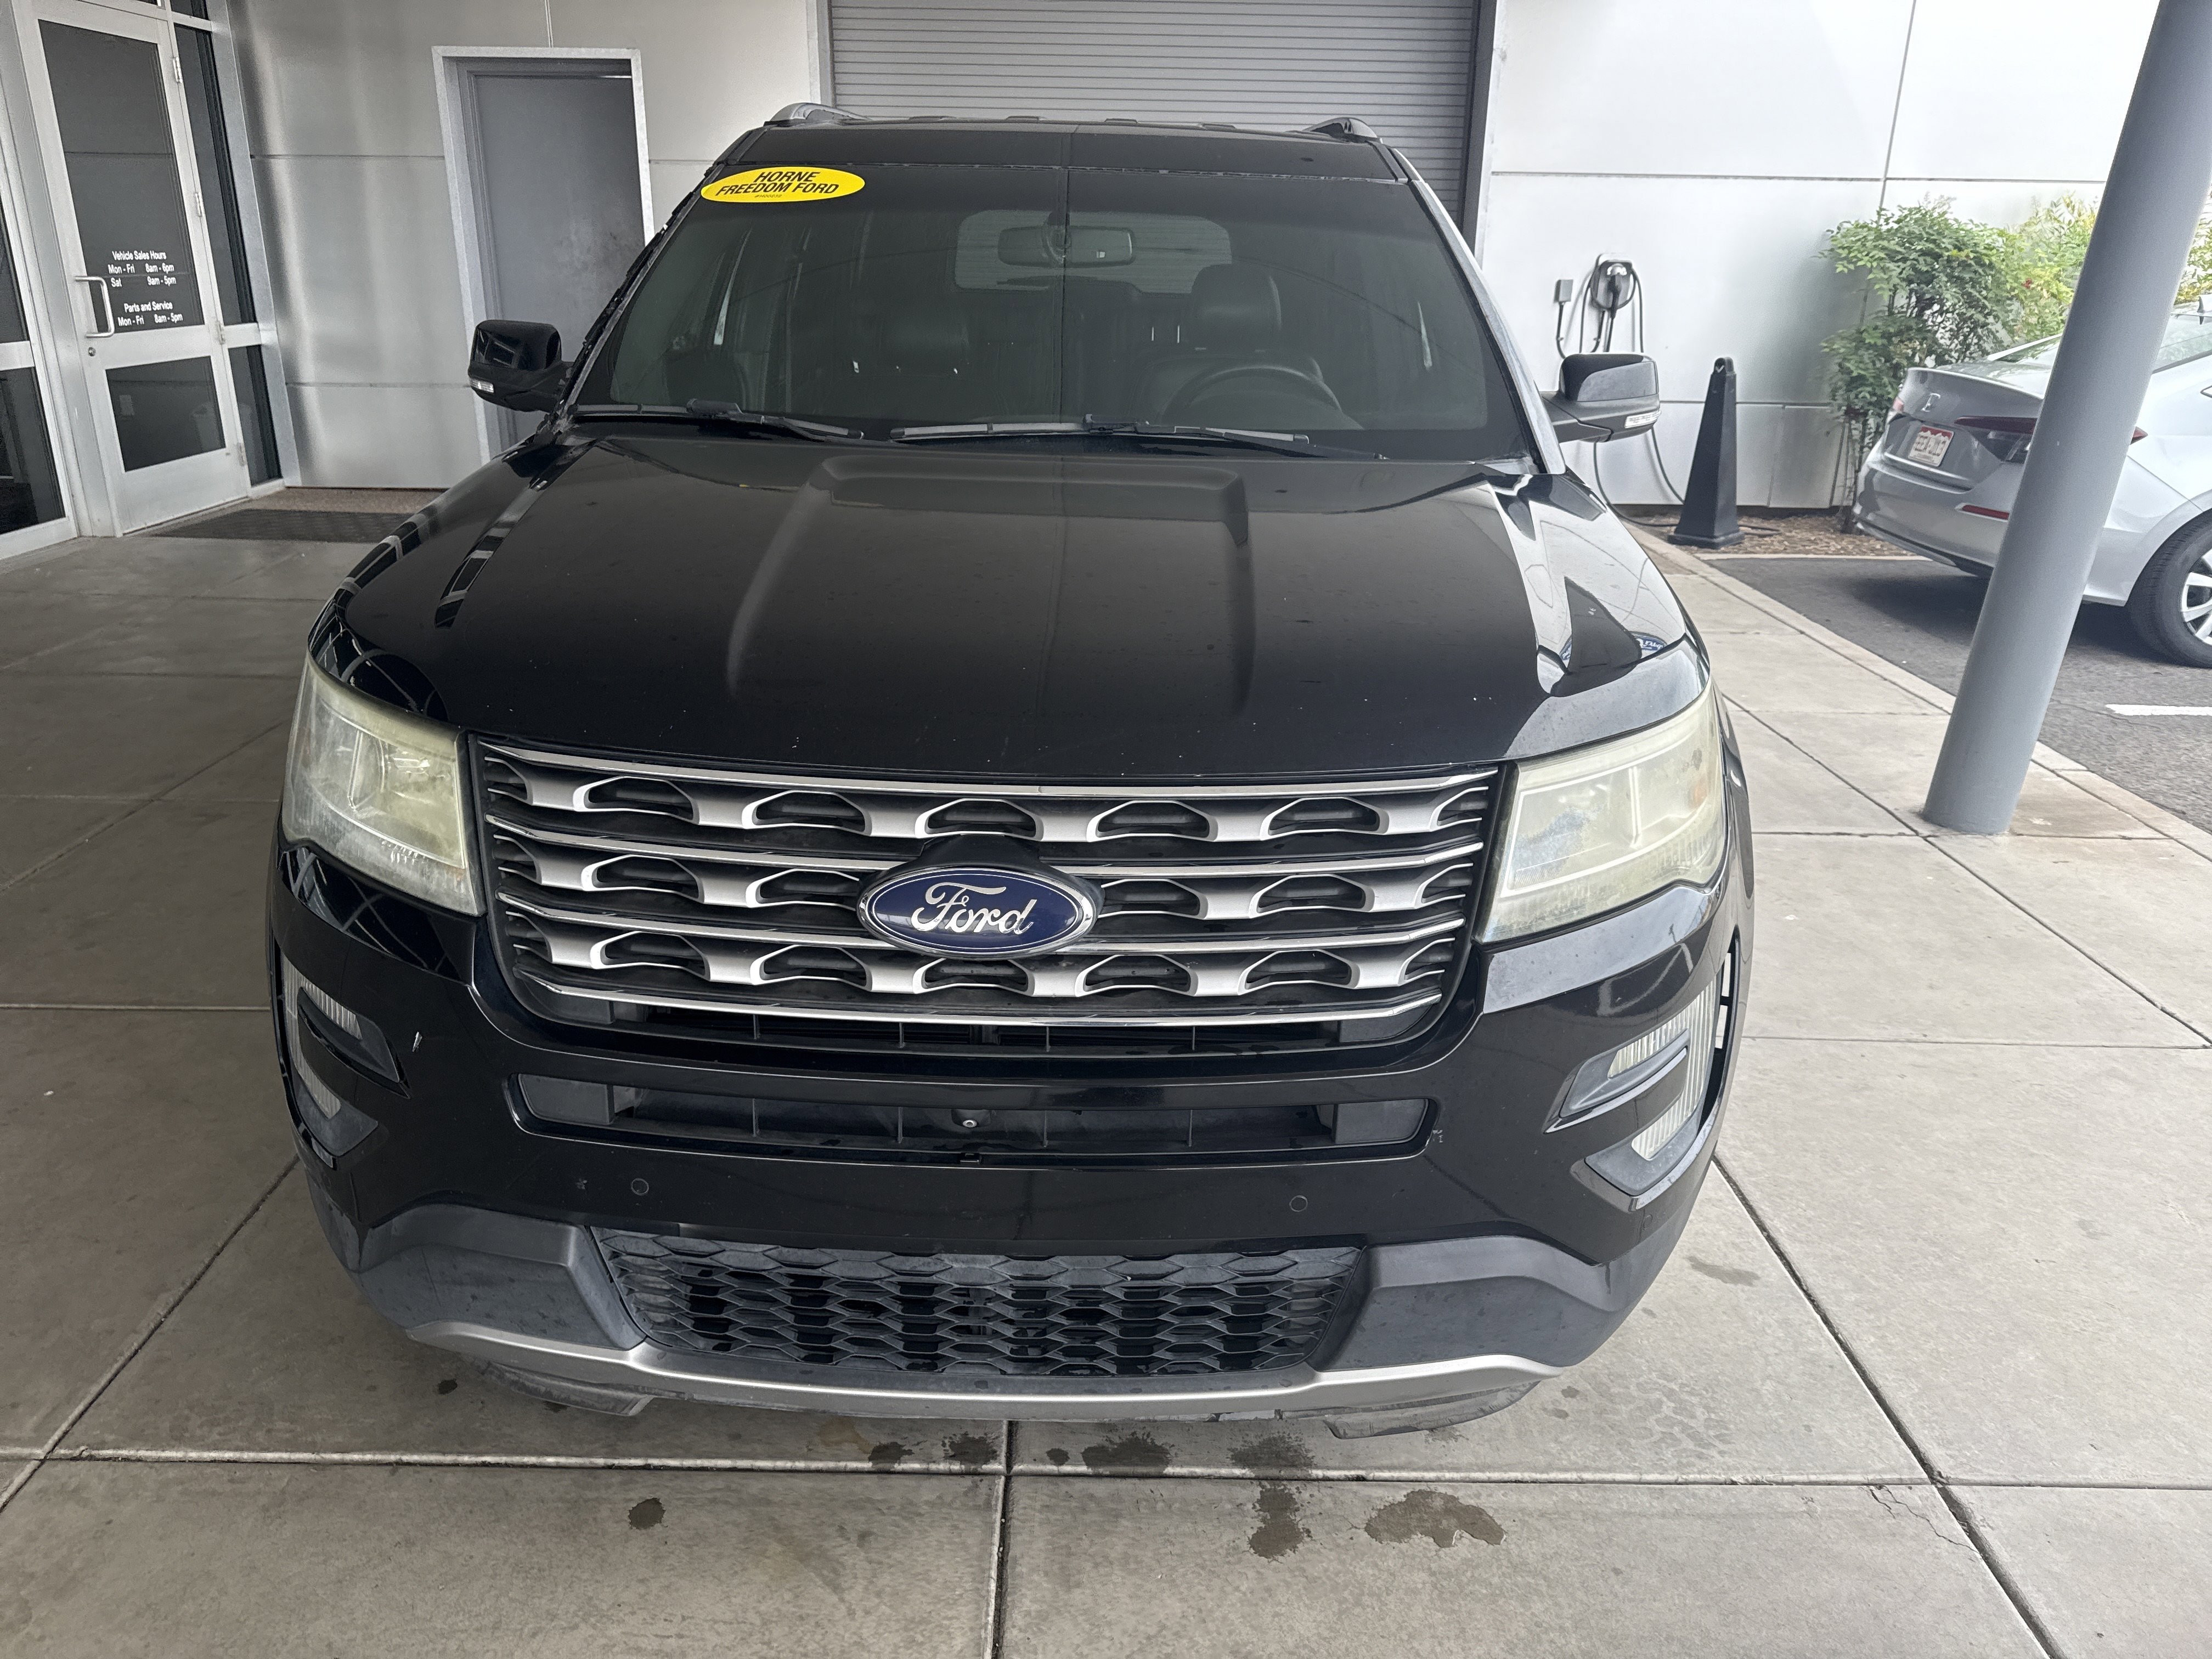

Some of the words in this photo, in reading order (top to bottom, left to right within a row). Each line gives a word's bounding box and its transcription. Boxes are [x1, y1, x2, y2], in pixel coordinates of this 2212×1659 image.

[753, 171, 821, 182] HORNE
[715, 183, 792, 196] FREEDOM
[792, 183, 839, 194] FORD
[112, 251, 133, 261] Vehicle
[134, 250, 149, 260] Sales
[150, 250, 167, 259] Hours
[108, 264, 122, 274] Mon
[126, 264, 135, 273] Fri
[145, 263, 158, 273] 8am
[162, 263, 174, 274] 6pm
[111, 278, 122, 287] Sat
[147, 276, 160, 285] 9am
[165, 275, 177, 286] 5pm
[124, 303, 140, 313] Parts
[141, 302, 151, 311] and
[152, 301, 173, 311] Service
[118, 317, 132, 326] Mon
[136, 315, 144, 325] Fri
[154, 314, 167, 323] 8am
[171, 313, 183, 324] 5pm
[911, 882, 1037, 935] Ford
